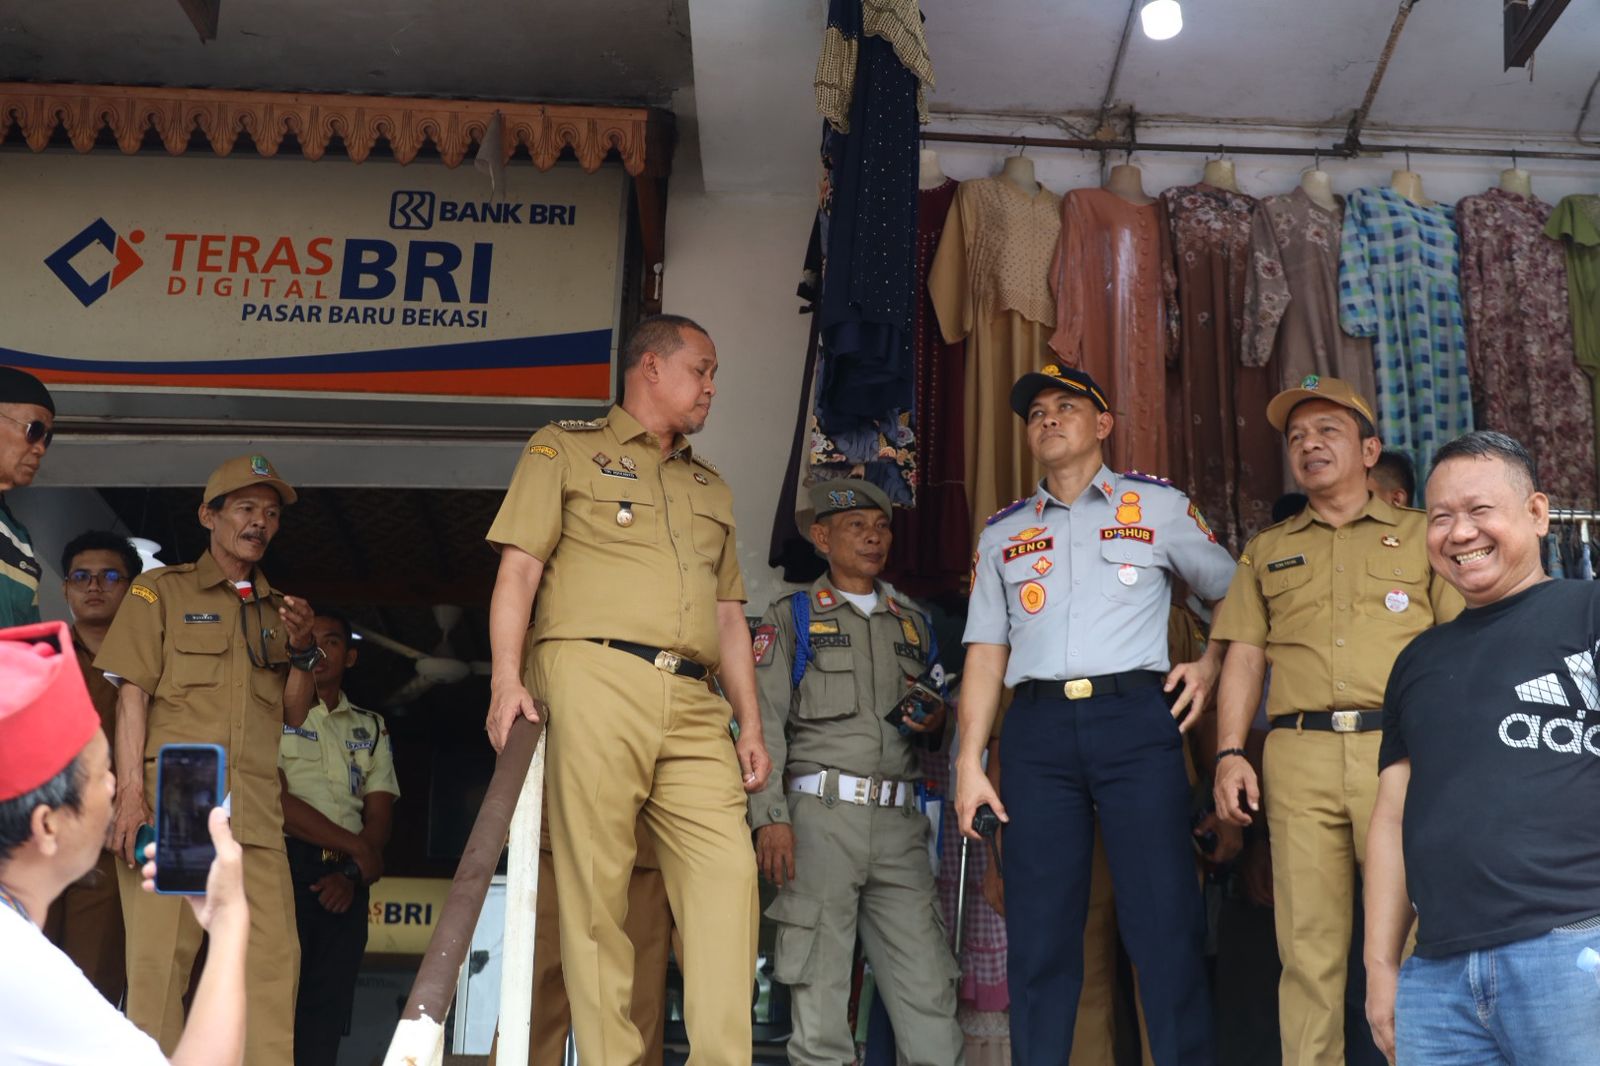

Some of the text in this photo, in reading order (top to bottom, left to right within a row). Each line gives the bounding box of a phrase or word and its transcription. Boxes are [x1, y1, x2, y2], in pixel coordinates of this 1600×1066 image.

[439, 201, 576, 226] BANK BRI
[165, 233, 493, 304] TERAS BRI
[167, 276, 328, 299] DIGITAL
[241, 303, 488, 328] PASAR BARU BEKASI
[1104, 528, 1151, 540] DISHUB
[1009, 540, 1047, 557] ZENO
[384, 902, 432, 925] BRI
